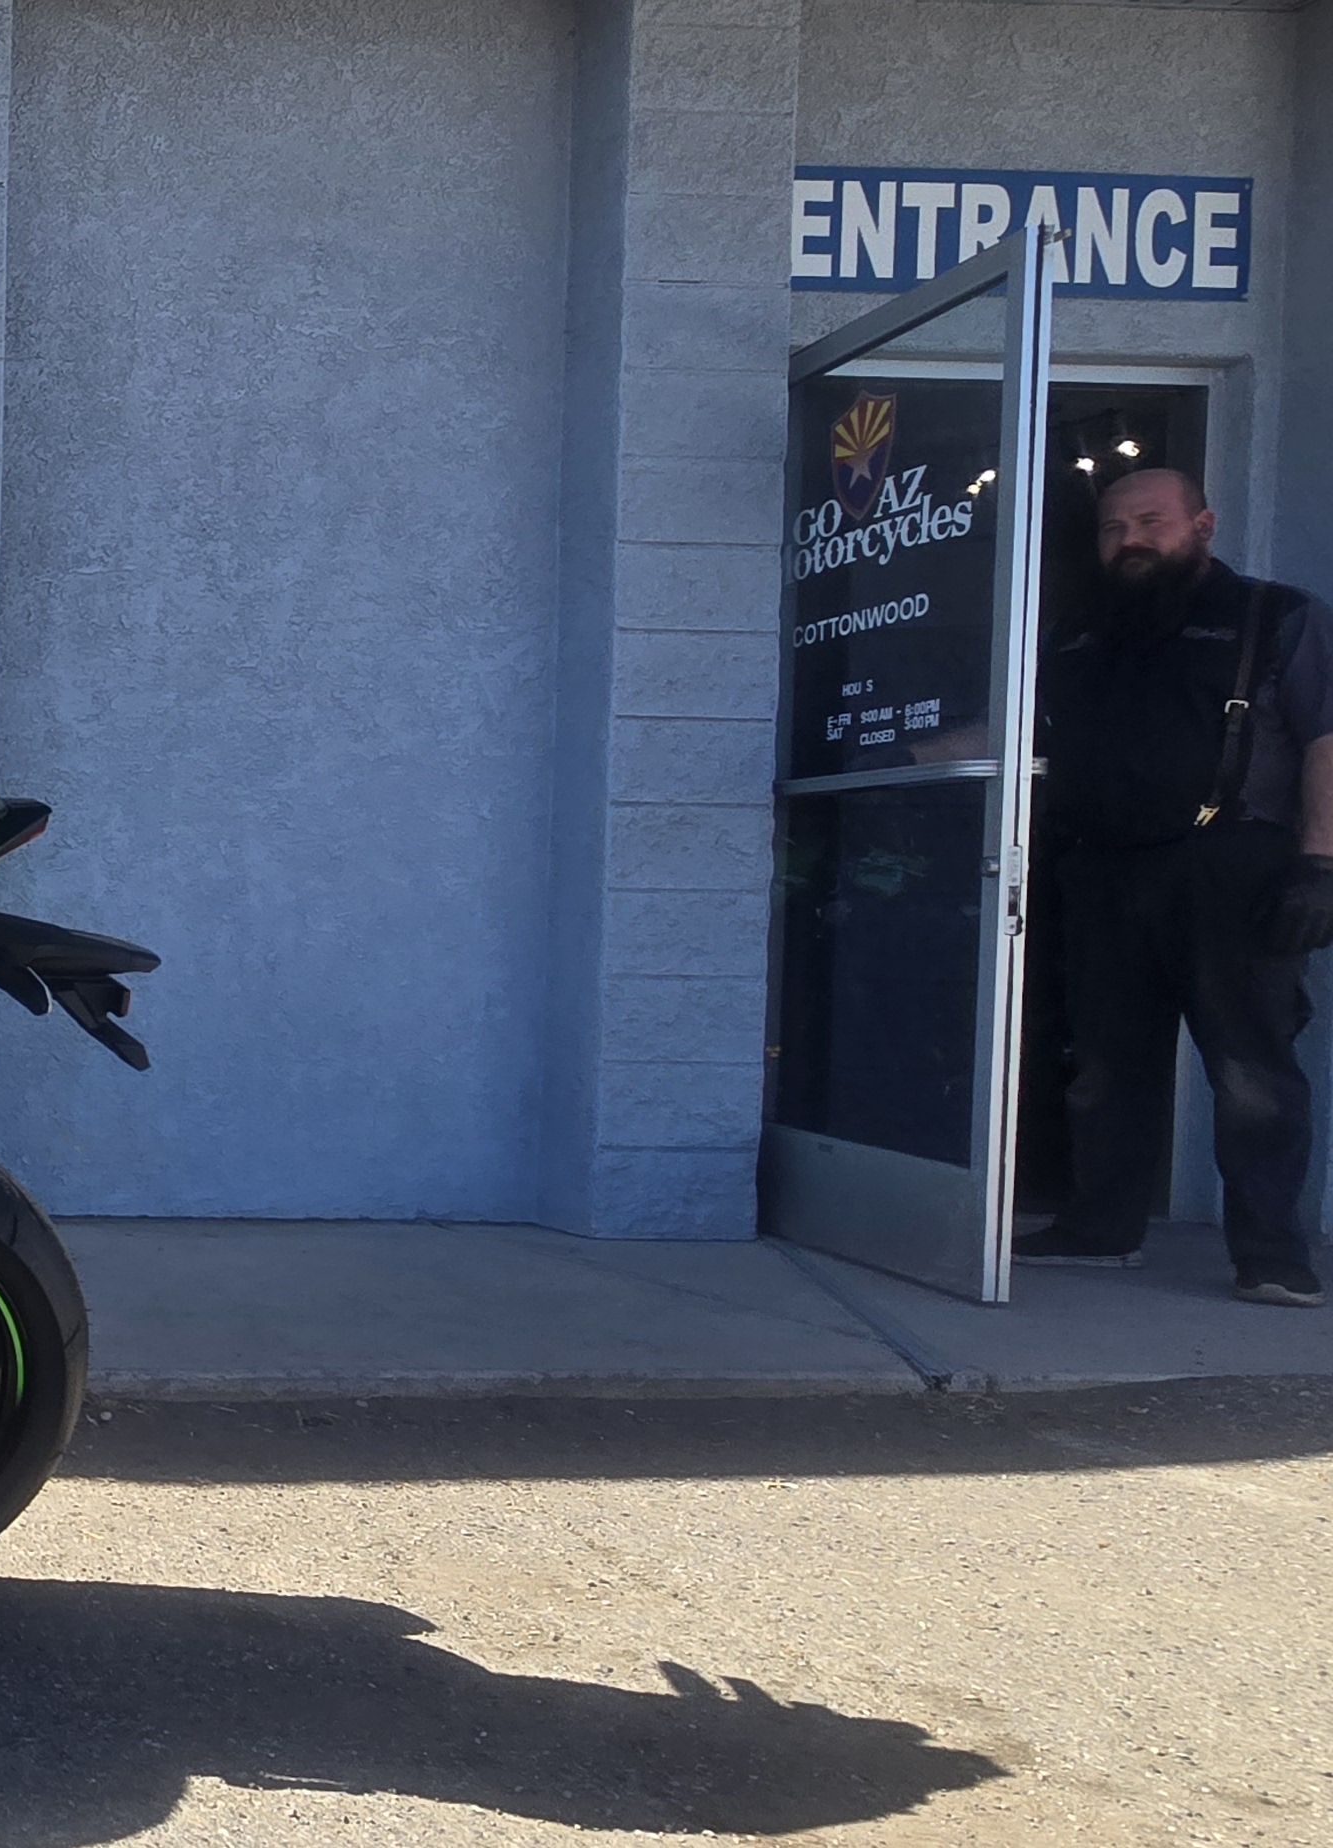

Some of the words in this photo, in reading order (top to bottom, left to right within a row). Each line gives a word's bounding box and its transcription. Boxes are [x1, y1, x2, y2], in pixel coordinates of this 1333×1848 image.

[791, 180, 1240, 288] ENTRANCE
[792, 499, 844, 546] GO
[873, 464, 927, 518] AZ
[792, 593, 930, 648] COTTONWOOD
[826, 726, 844, 741] SAT
[859, 729, 895, 746] CLOSED
